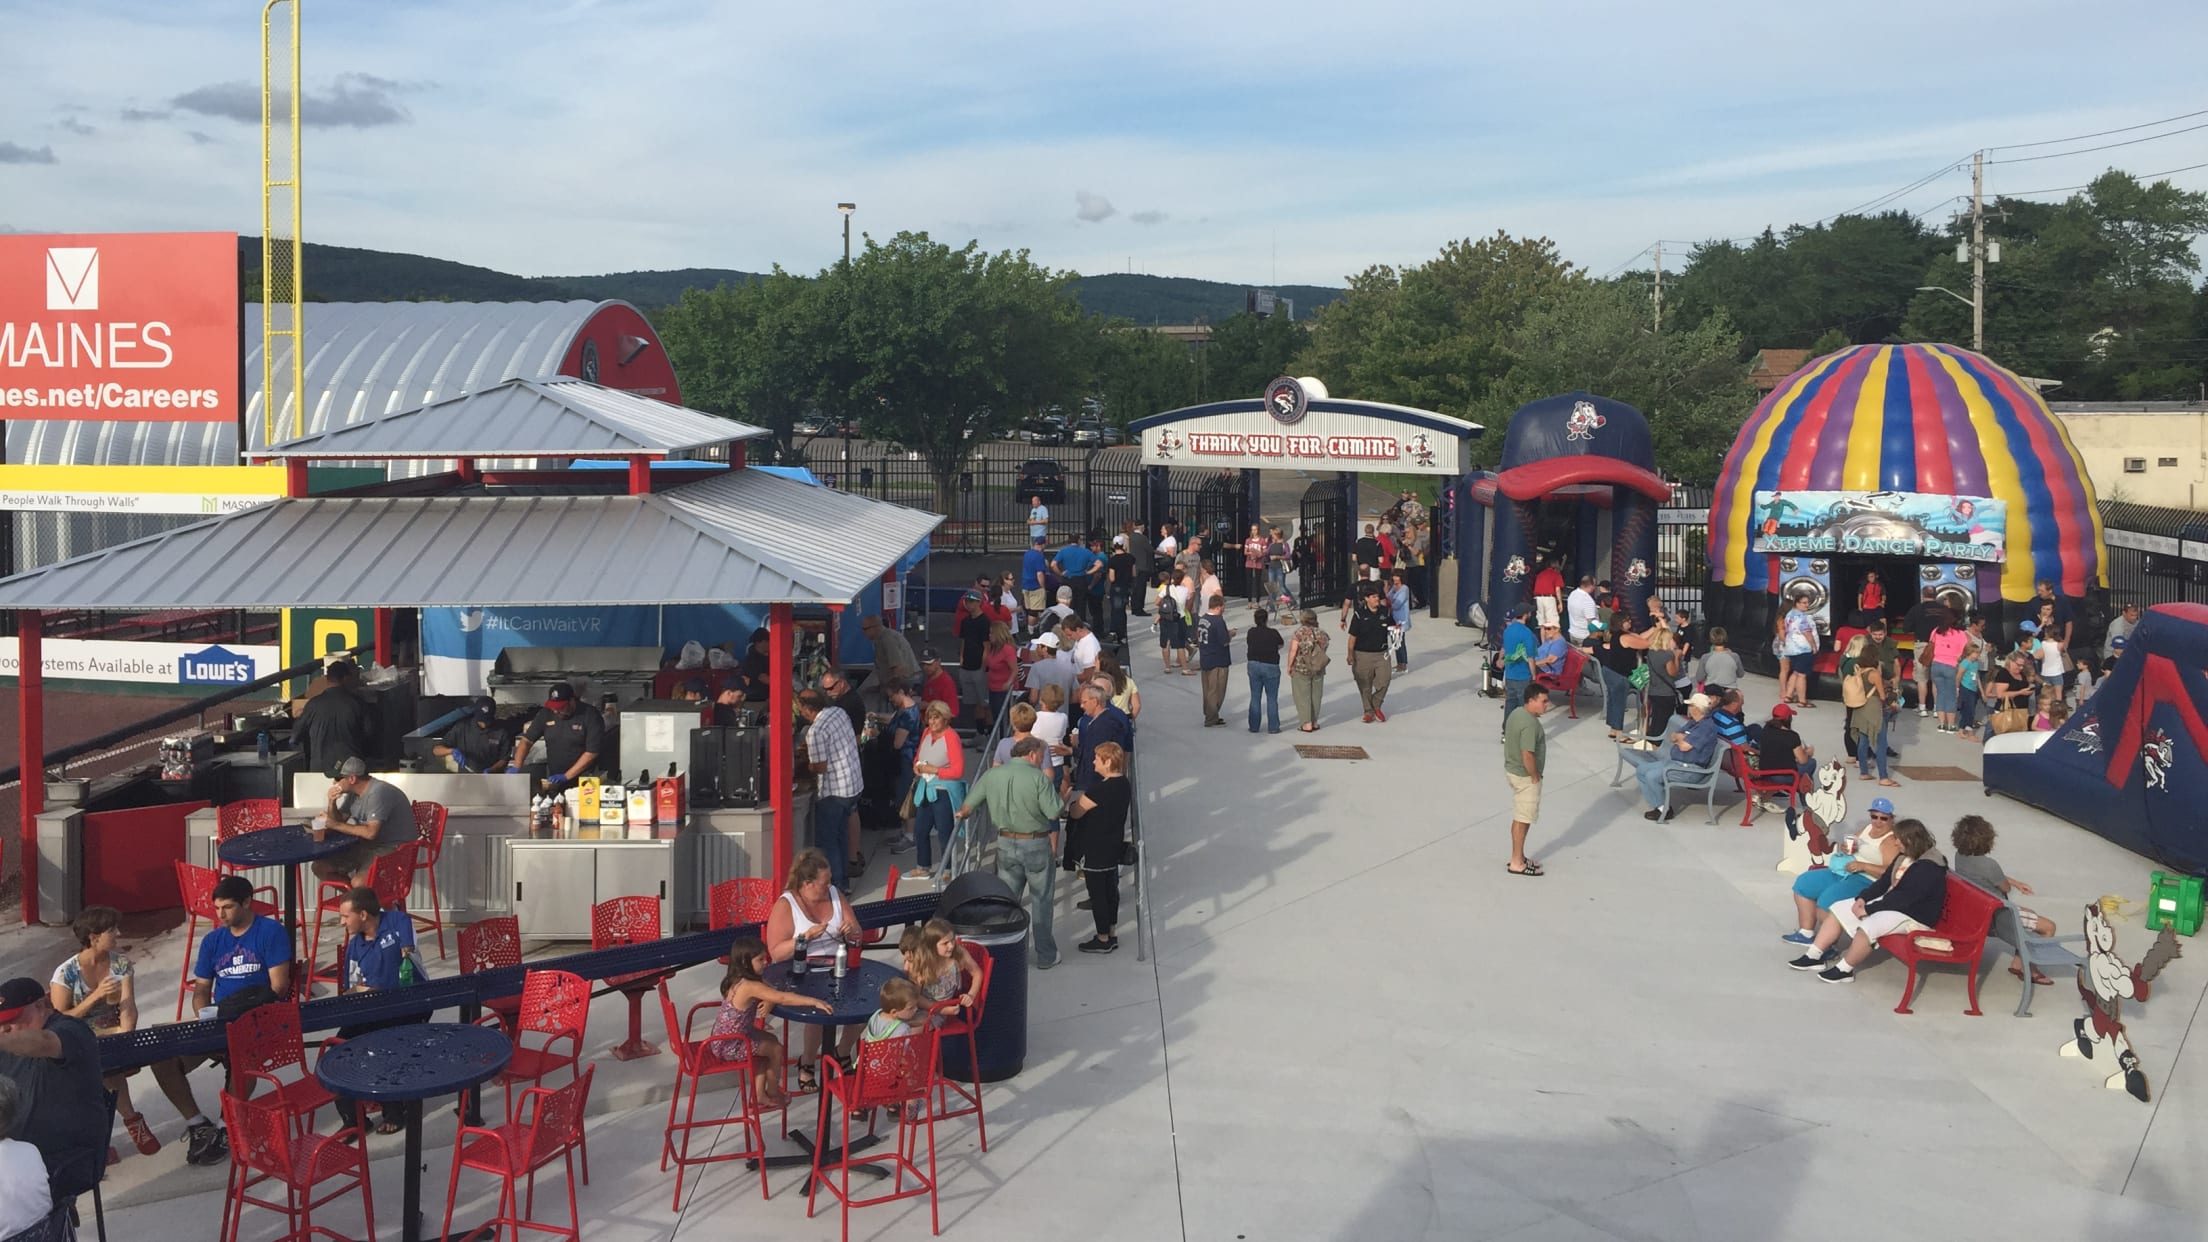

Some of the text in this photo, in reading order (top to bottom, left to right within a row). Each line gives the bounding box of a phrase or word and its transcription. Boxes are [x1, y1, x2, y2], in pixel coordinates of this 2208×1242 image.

[1189, 433, 1397, 459] THANK YOU FOR COMING
[2, 494, 35, 508] People
[37, 495, 62, 506] Walk
[65, 496, 105, 509] Through
[1764, 534, 1992, 558] XTREME DANCE PARTY
[486, 615, 601, 632] #ItCanWaitVR
[41, 658, 84, 672] stems
[88, 657, 154, 674] Available
[158, 662, 172, 675] at
[186, 659, 248, 682] LOWE'S
